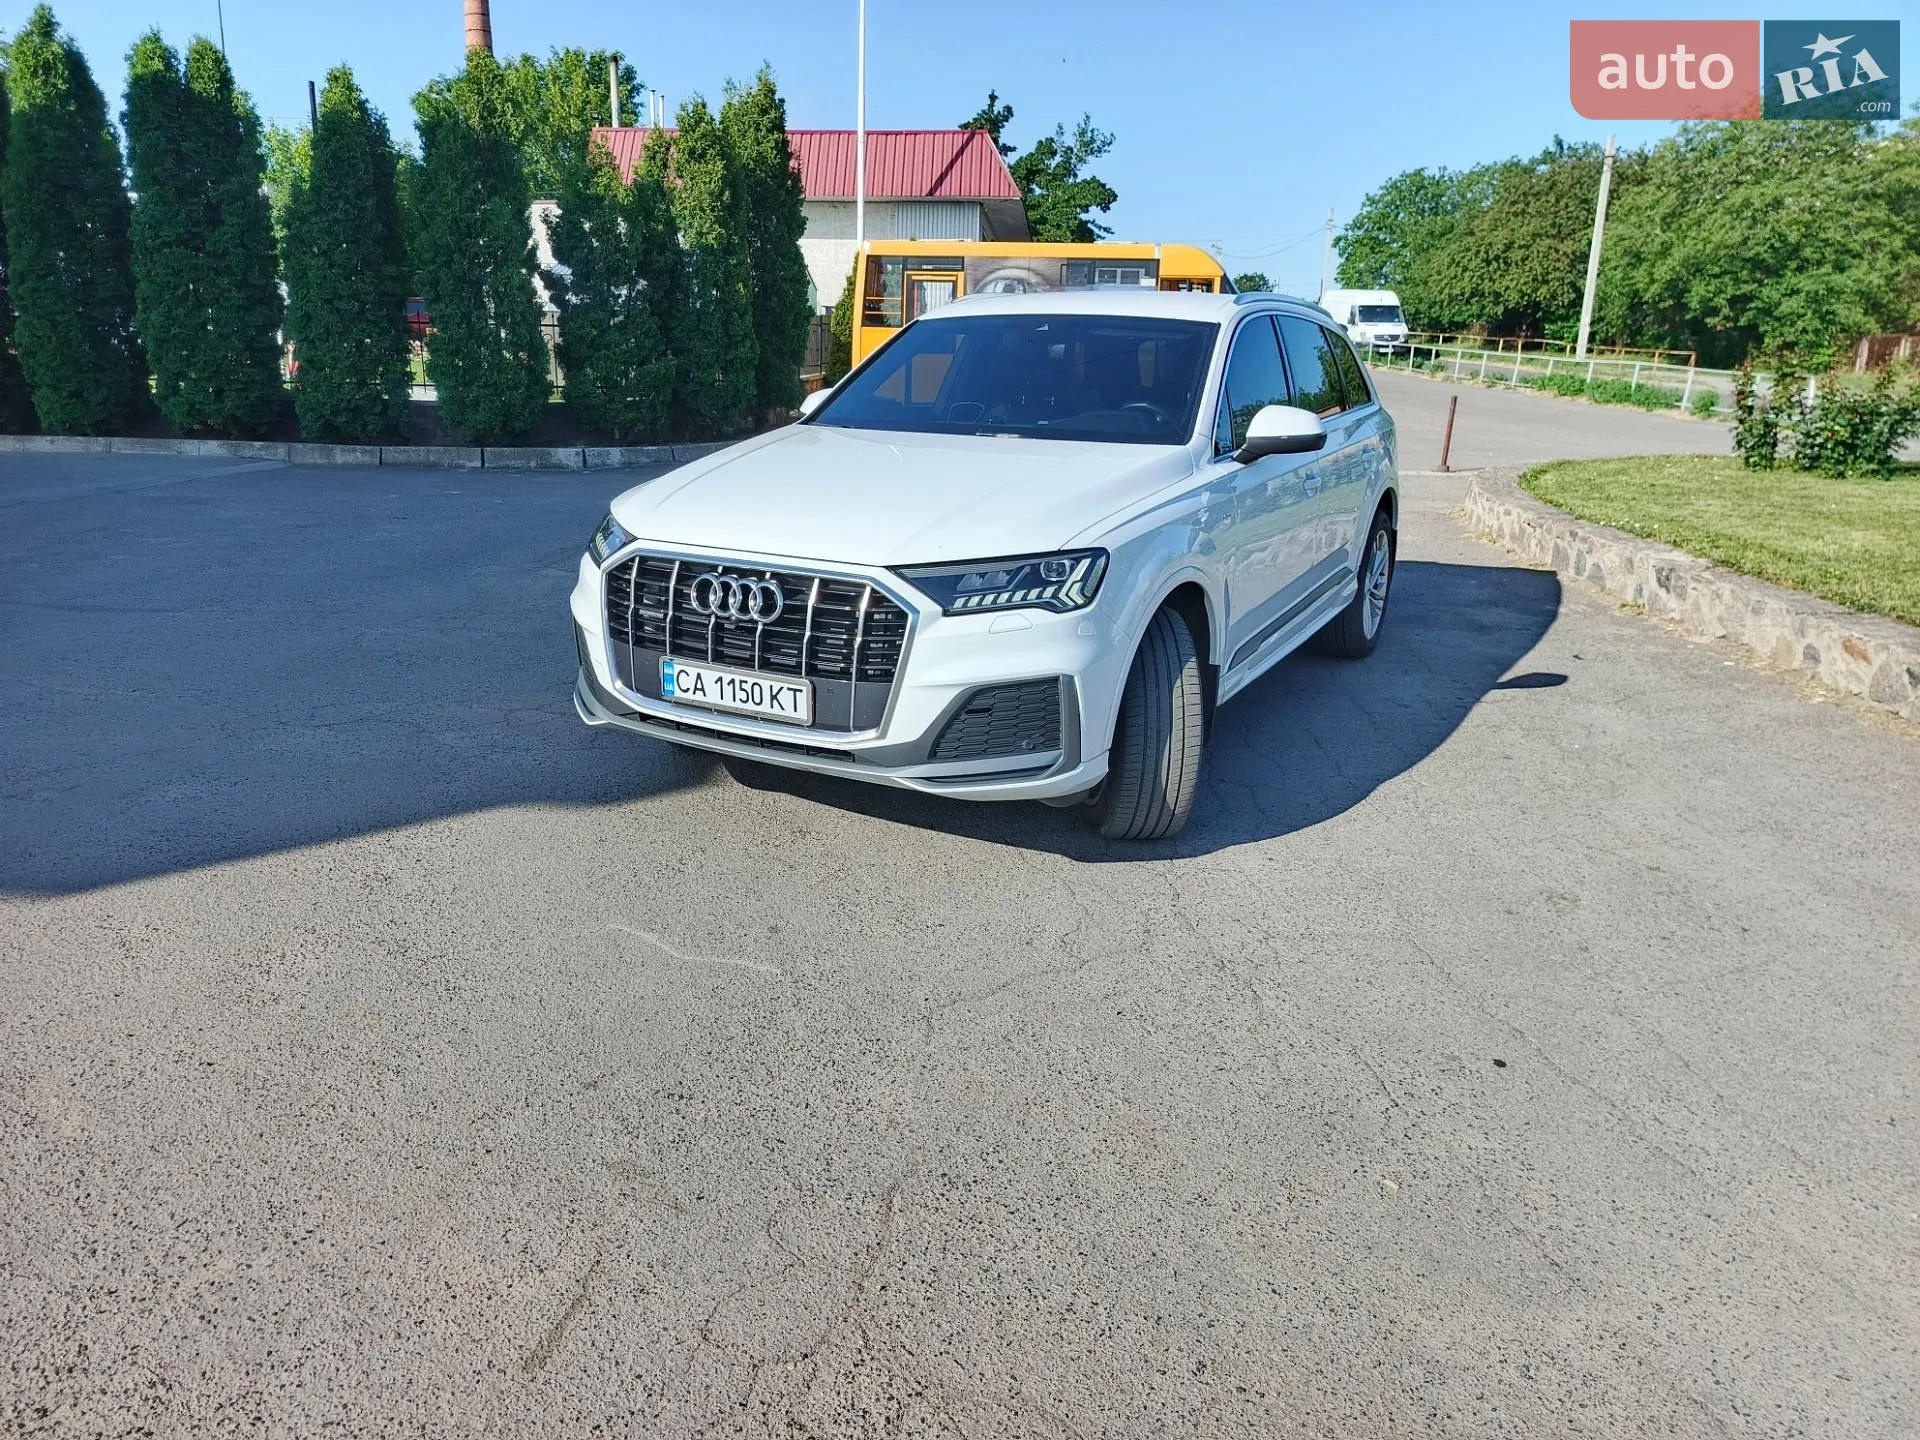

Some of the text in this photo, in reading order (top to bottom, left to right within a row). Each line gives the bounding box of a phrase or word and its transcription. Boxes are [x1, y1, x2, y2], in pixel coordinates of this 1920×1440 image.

[676, 669, 803, 713] CA 1150 KT
